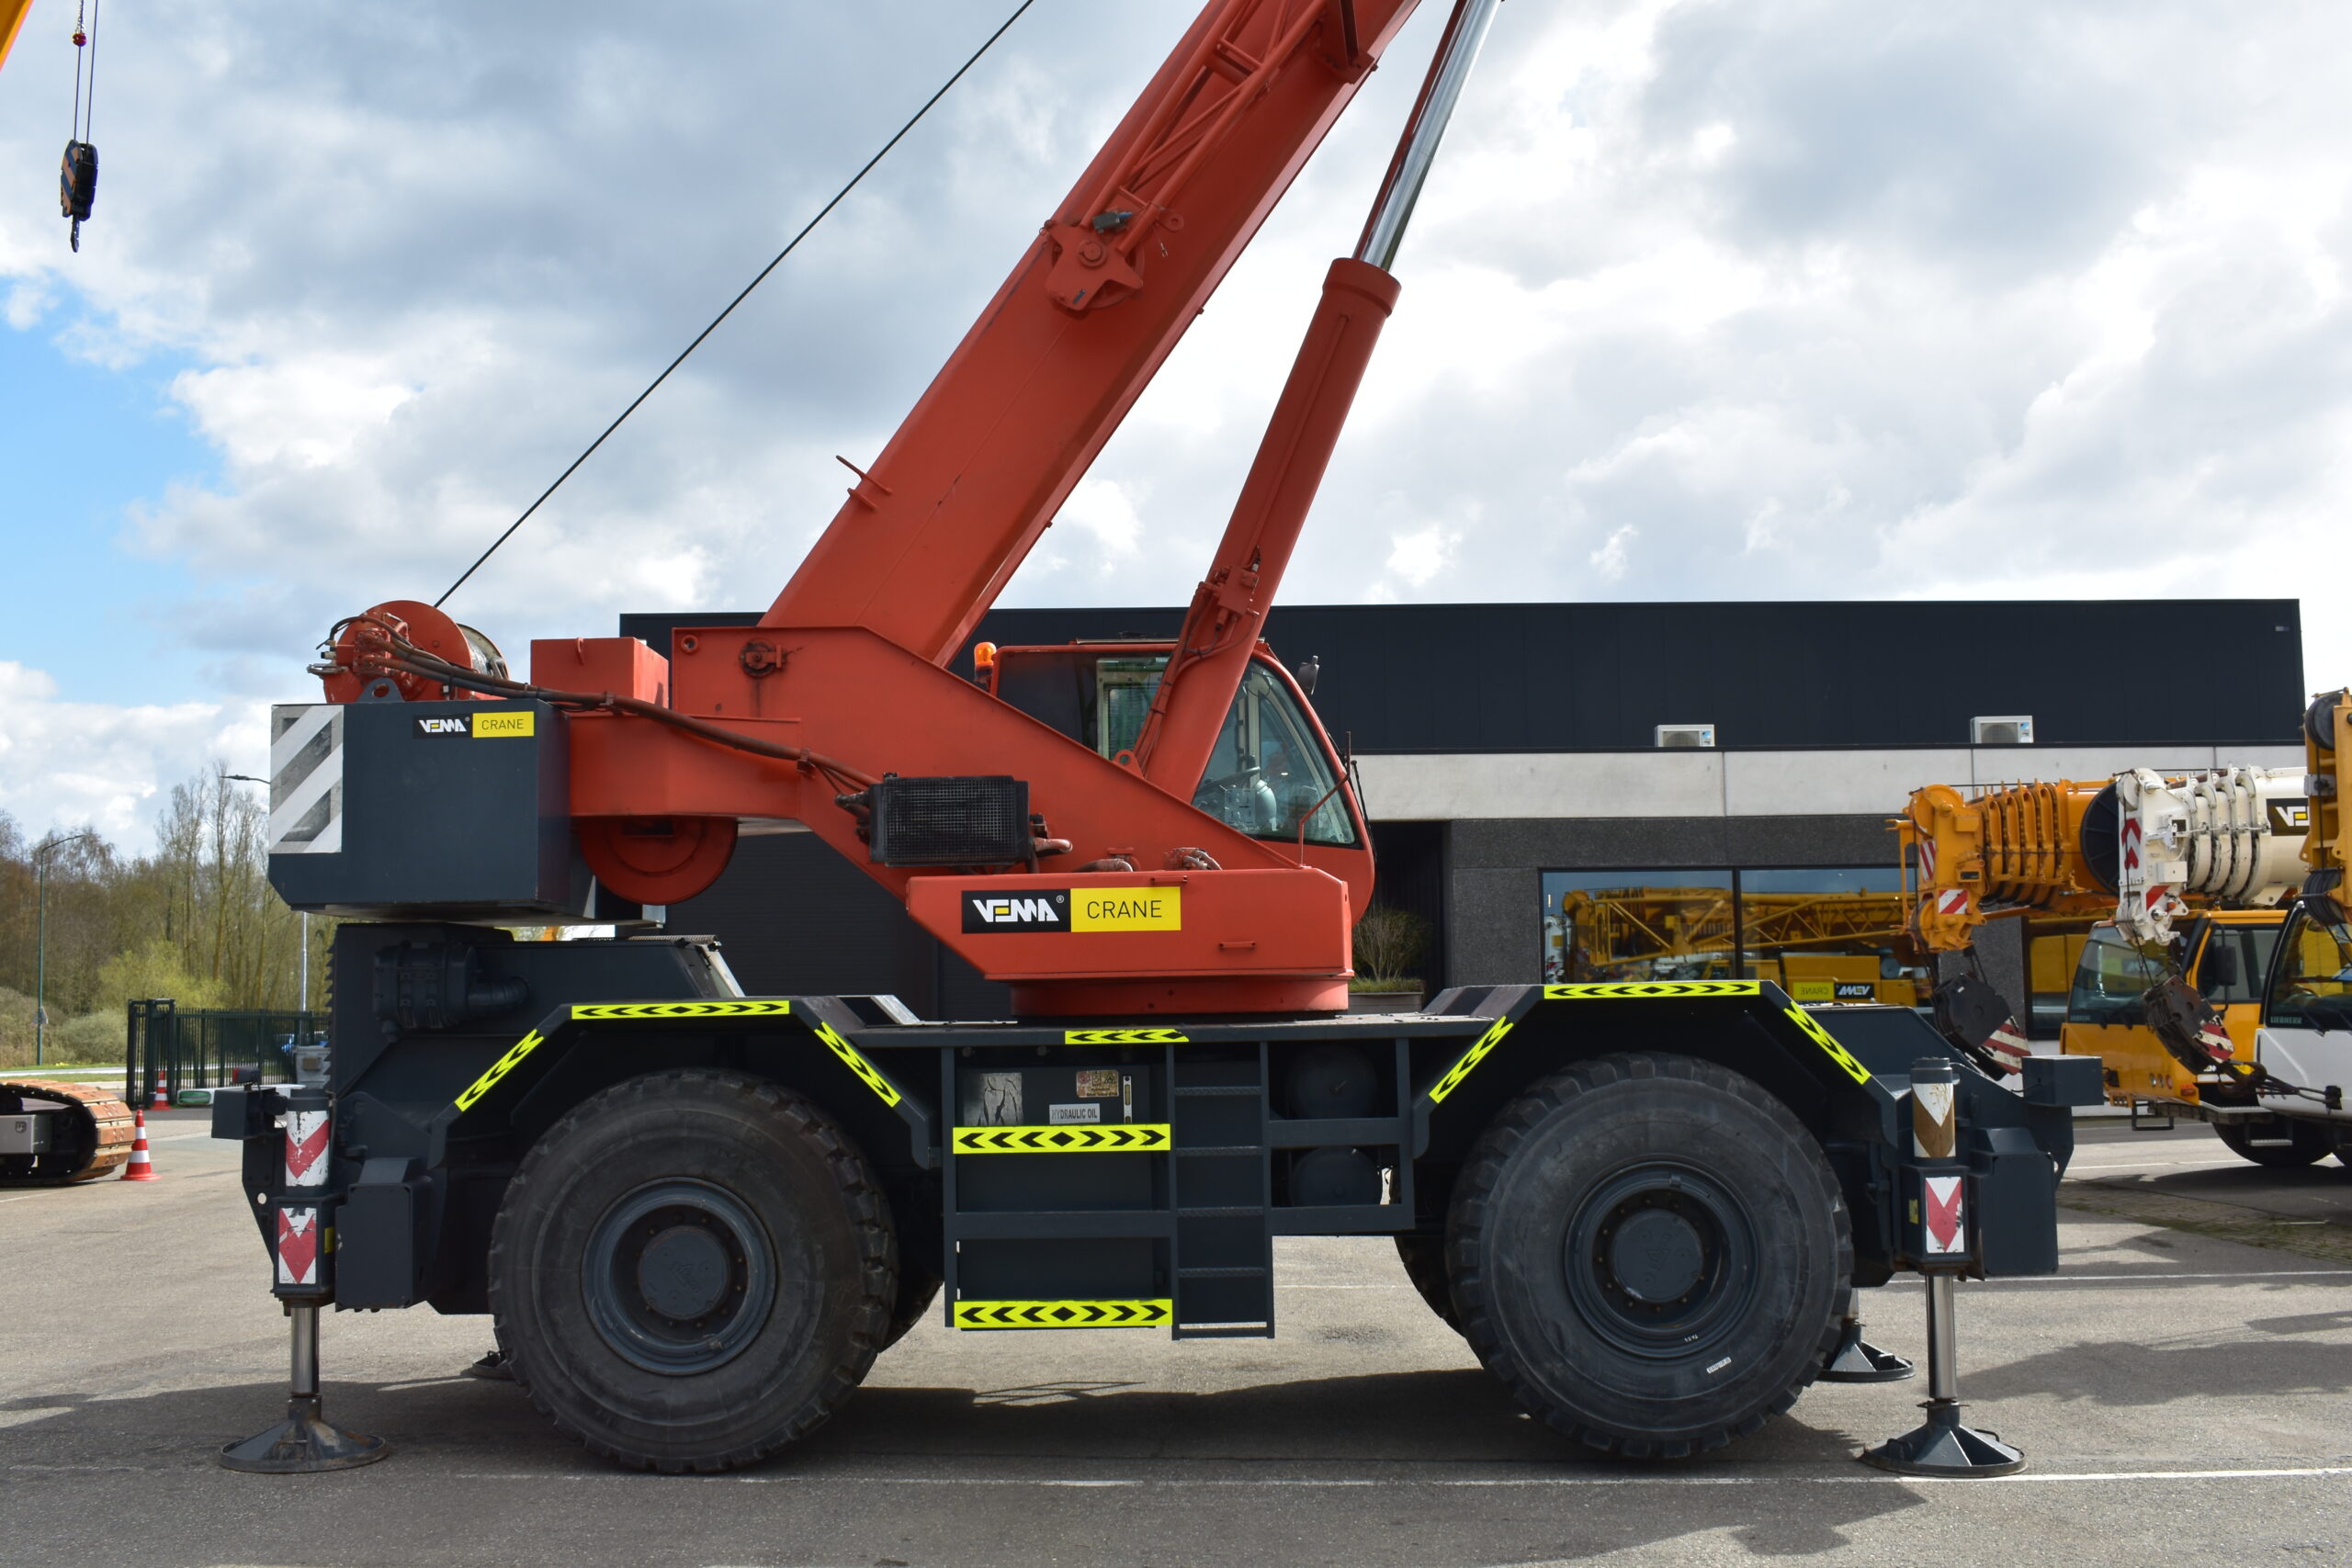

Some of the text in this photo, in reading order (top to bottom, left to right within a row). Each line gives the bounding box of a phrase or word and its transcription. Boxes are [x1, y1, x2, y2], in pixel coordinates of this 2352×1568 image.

[481, 718, 525, 730] CRANE
[1087, 900, 1162, 919] CRANE
[1051, 1108, 1098, 1120] HYDRAULIC OIL
